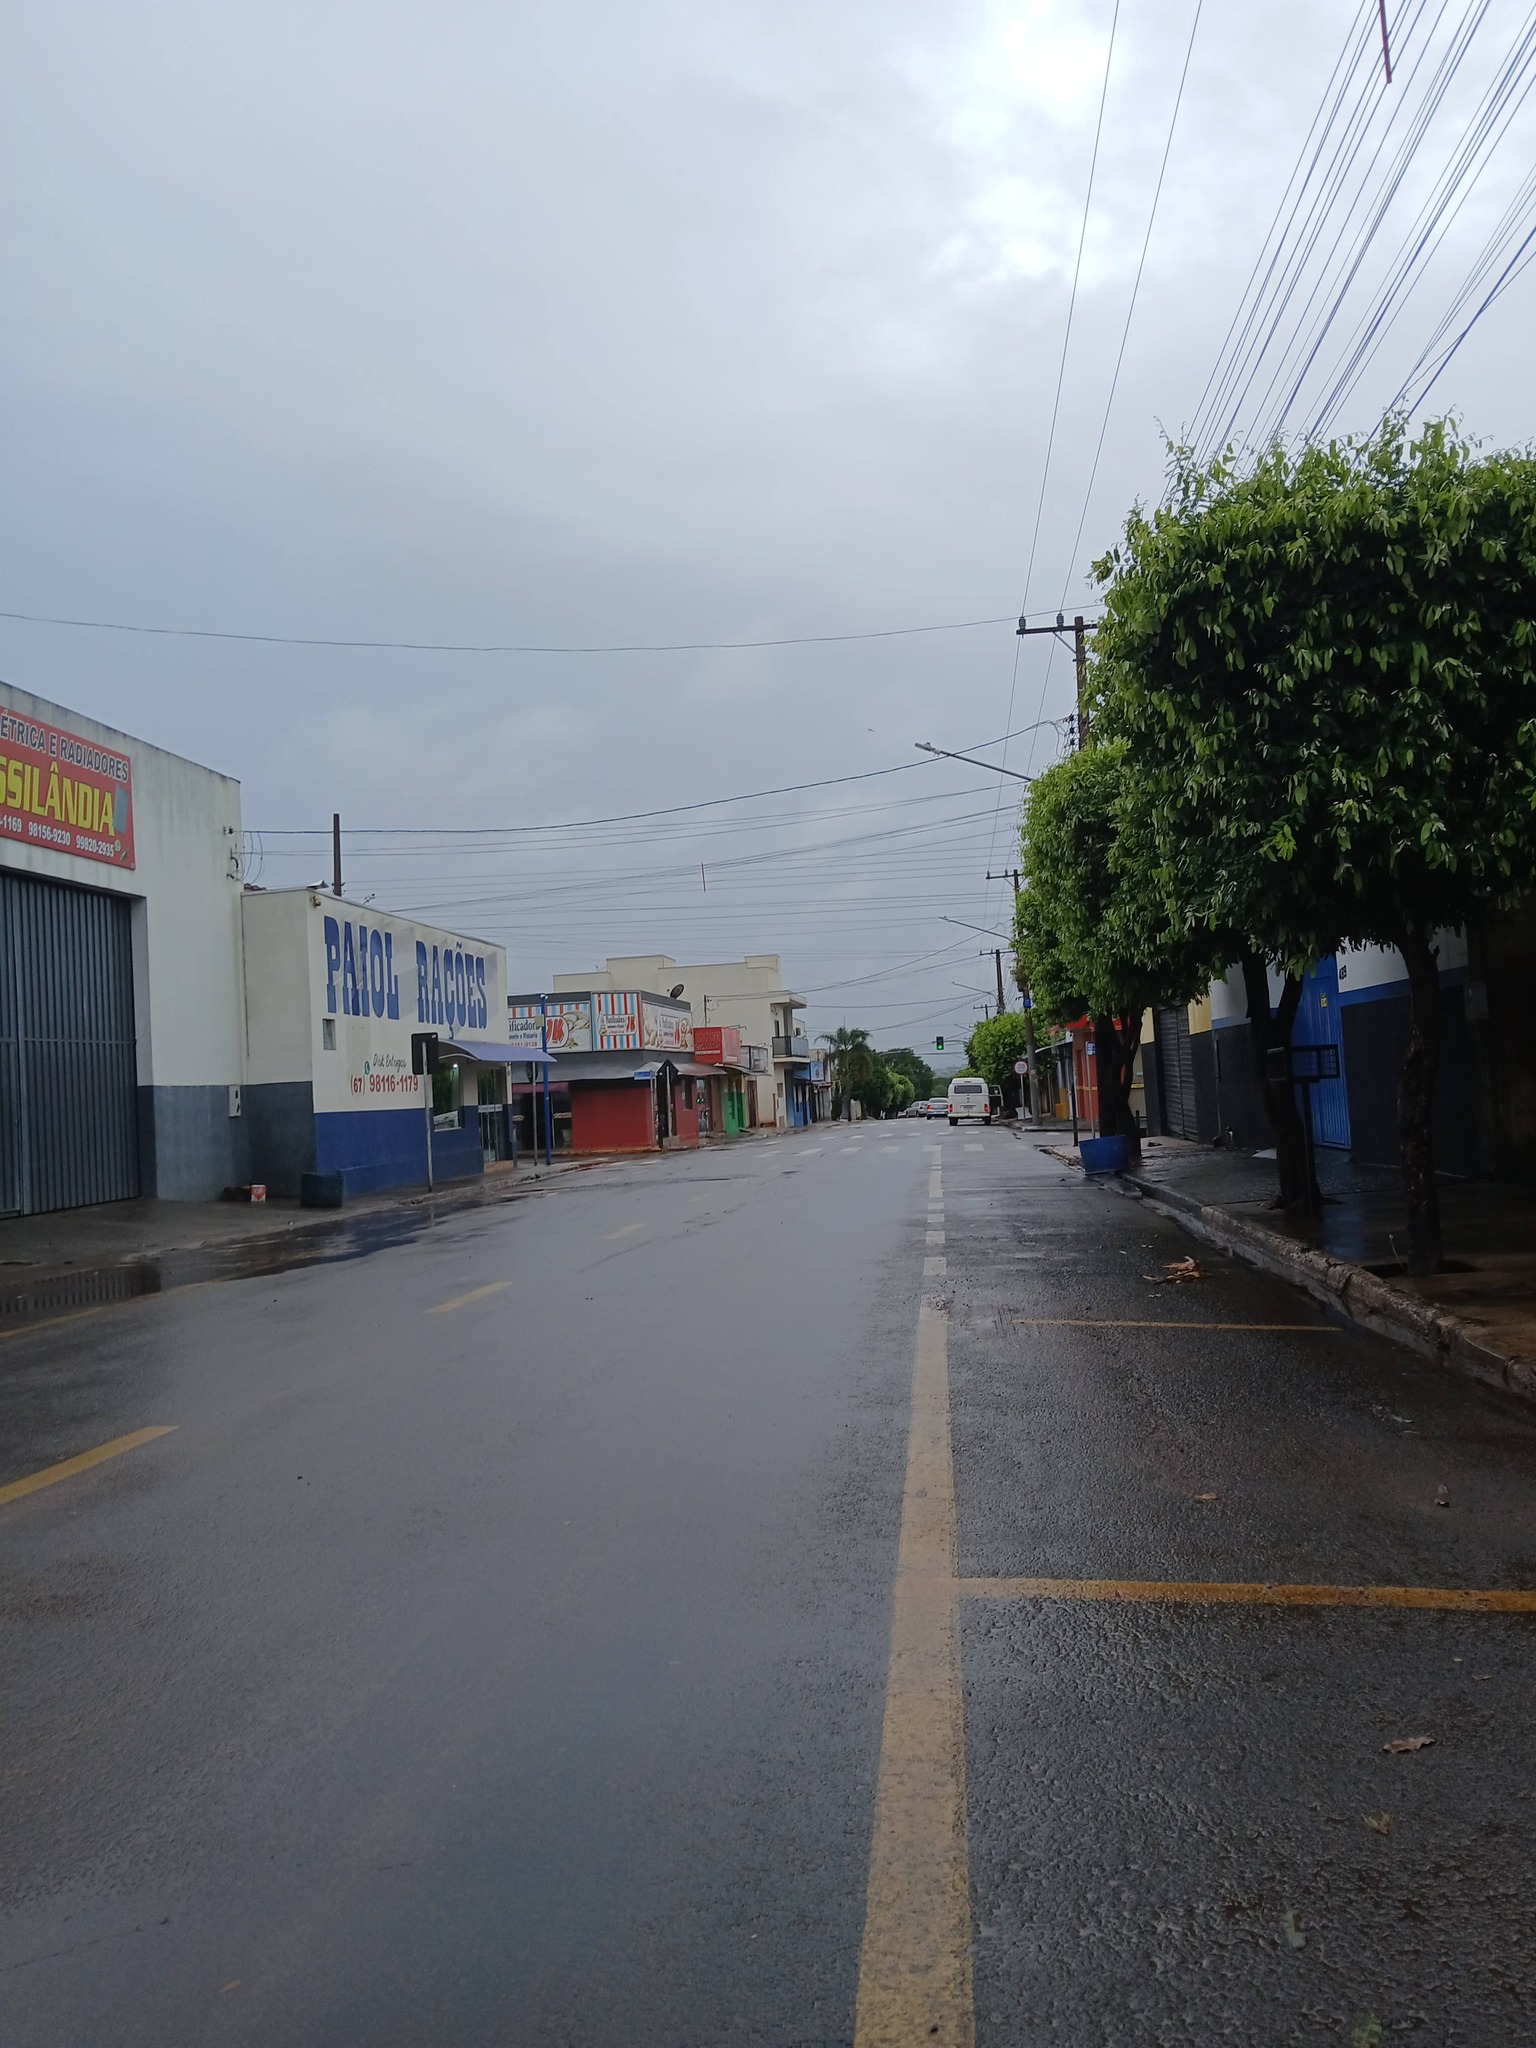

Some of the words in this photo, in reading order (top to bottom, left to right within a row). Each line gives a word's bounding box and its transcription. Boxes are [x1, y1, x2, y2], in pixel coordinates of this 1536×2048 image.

[49, 733, 57, 757] E
[59, 736, 129, 783] RADIADORES
[28, 822, 71, 847] 98156-9230
[324, 915, 400, 1021] PAIOL
[416, 942, 487, 1040] RAÇÕES
[351, 1074, 365, 1096] (67)
